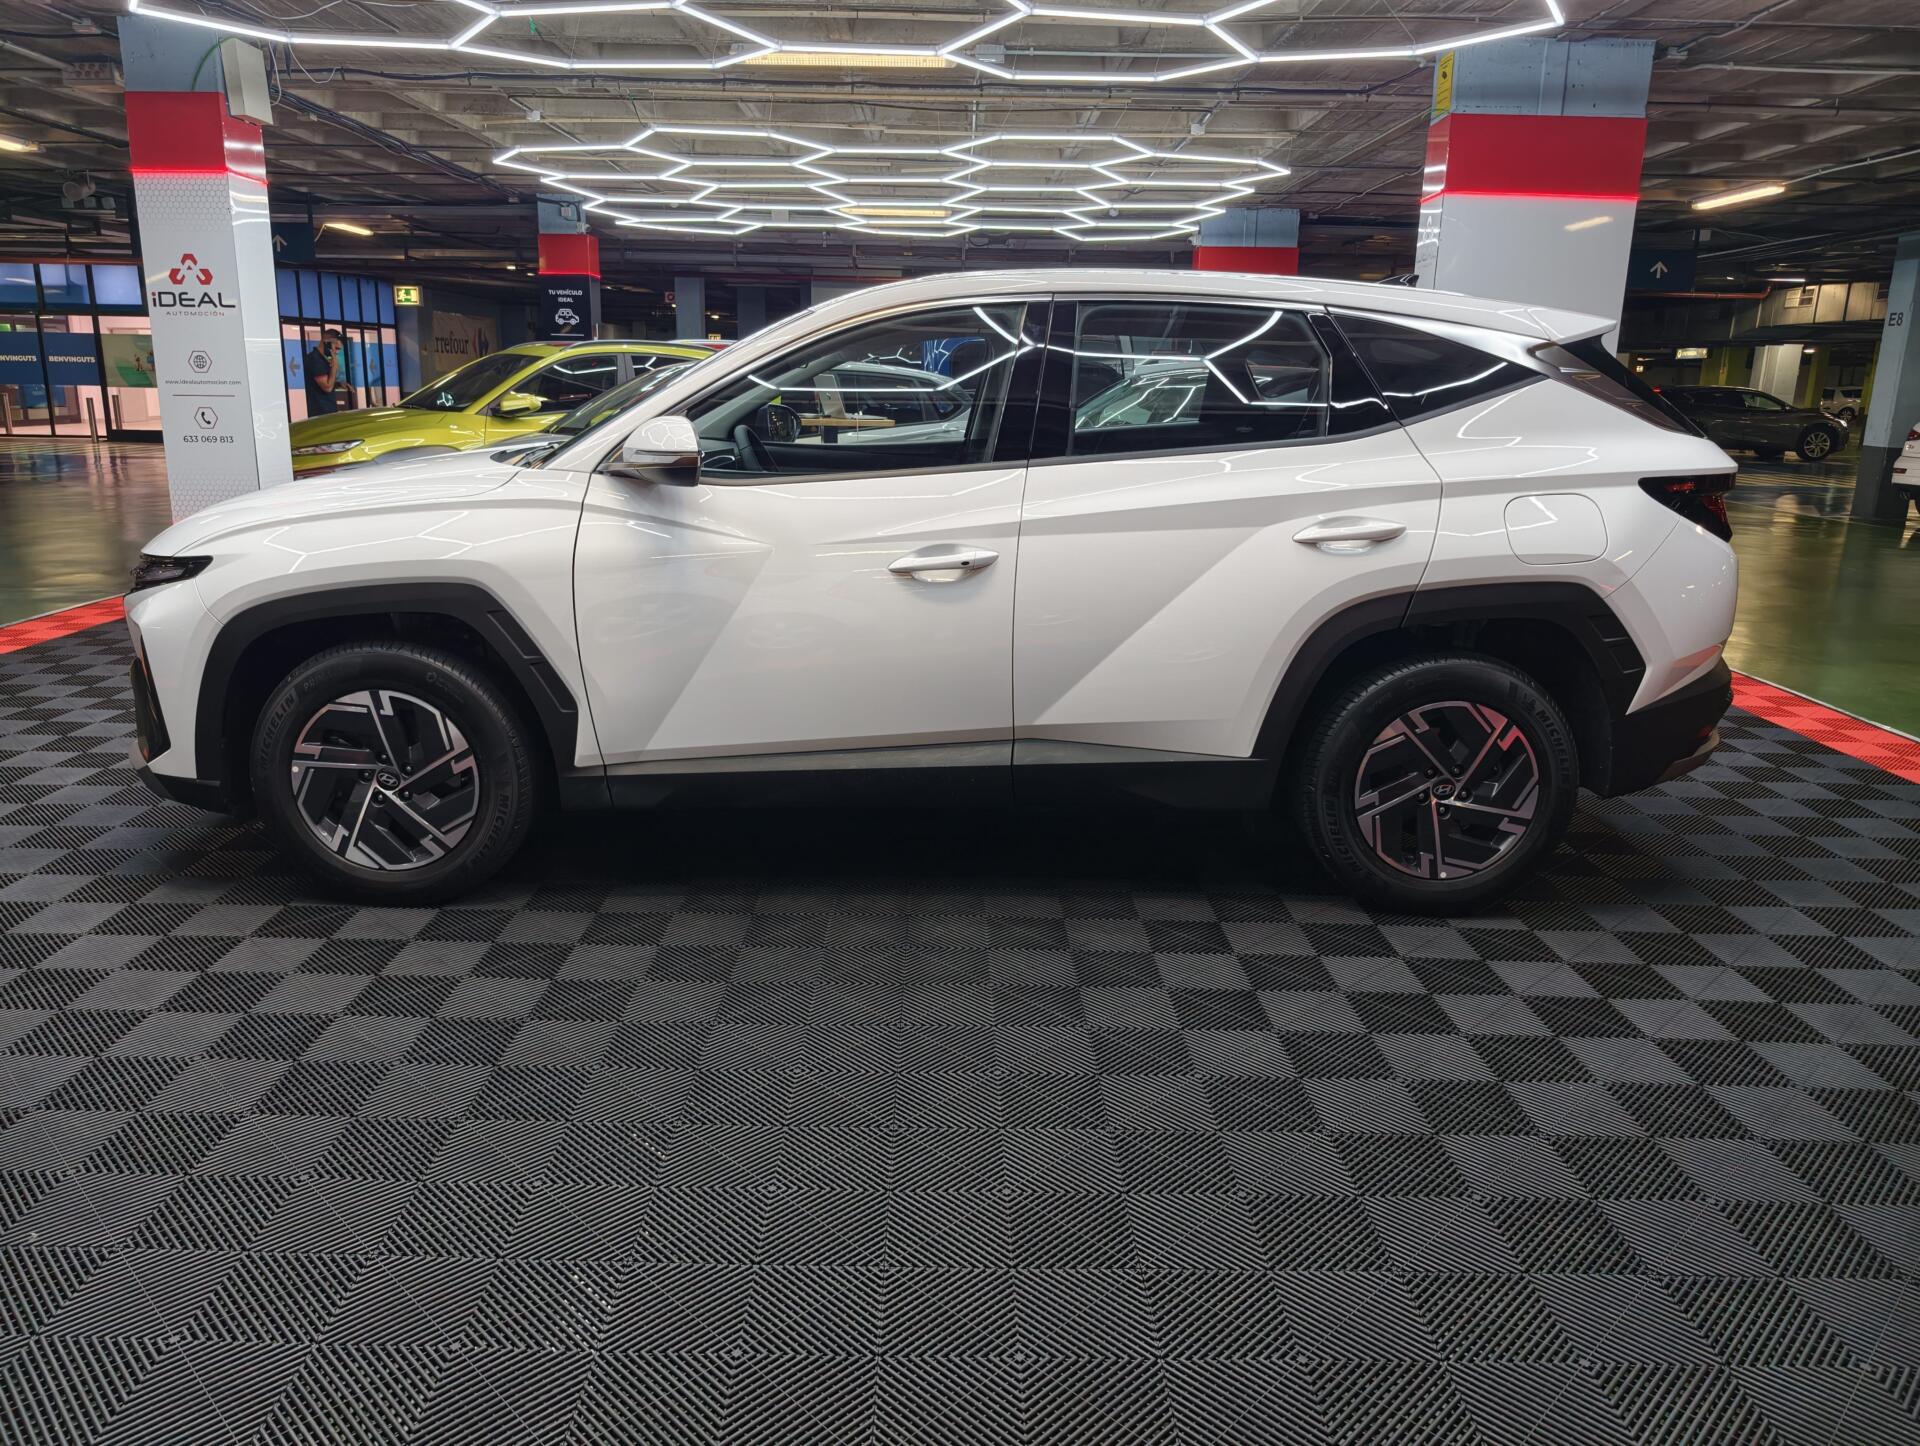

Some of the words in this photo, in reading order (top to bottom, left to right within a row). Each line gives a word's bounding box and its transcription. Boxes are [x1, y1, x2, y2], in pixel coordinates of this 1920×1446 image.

[1888, 311, 1904, 327] E8
[434, 331, 469, 354] rrefour
[48, 355, 96, 363] BENVINGUTS
[183, 435, 199, 443] 633
[201, 435, 218, 444] 069
[219, 435, 234, 444] 813
